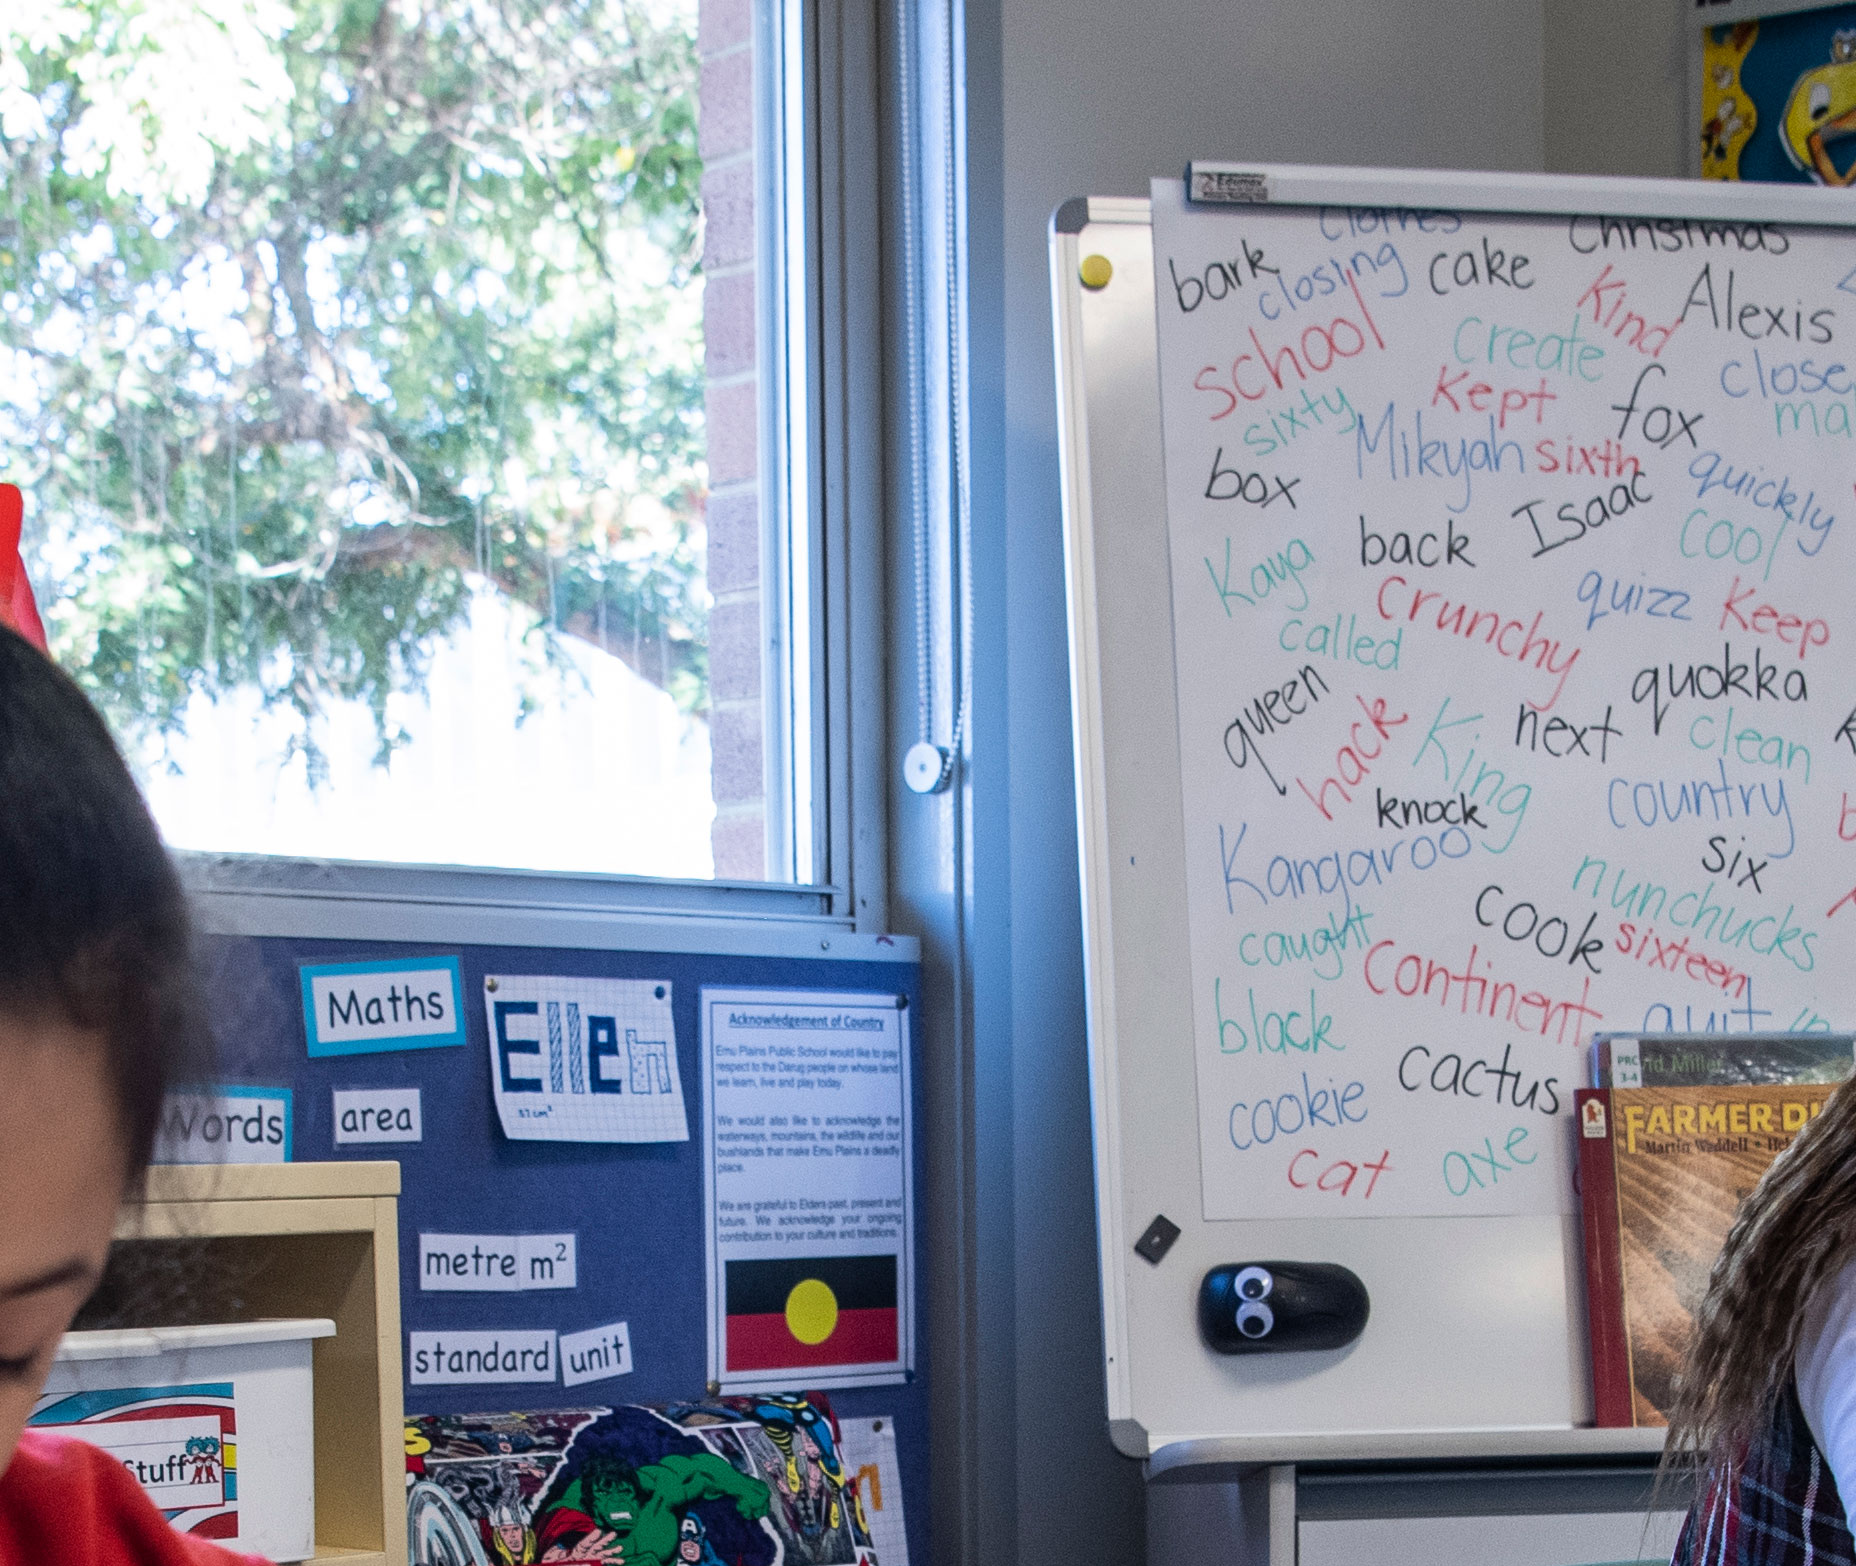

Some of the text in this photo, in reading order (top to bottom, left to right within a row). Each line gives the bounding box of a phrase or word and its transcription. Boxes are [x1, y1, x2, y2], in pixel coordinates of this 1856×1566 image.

[1169, 238, 1279, 313] bark
[1259, 242, 1409, 320] closing
[1428, 238, 1535, 295] cake
[1680, 262, 1837, 344] Alexis
[1611, 363, 1704, 450] fox
[1720, 348, 1856, 399] close
[1244, 382, 1358, 457] sixty
[1204, 447, 1301, 509] box
[1356, 402, 1524, 513] Mikyah
[1536, 437, 1640, 478] sixth
[1512, 471, 1653, 558] Isaac
[1688, 450, 1836, 556] quickly
[1204, 537, 1316, 618] Kaya
[1359, 515, 1476, 568] back
[1680, 508, 1792, 582] cool
[1279, 613, 1404, 671] called
[1632, 642, 1807, 736] quokka
[1223, 665, 1330, 796] queen
[1296, 695, 1409, 822] hack
[1515, 703, 1623, 764] next
[1689, 707, 1812, 785] clean
[1377, 787, 1489, 831] knock
[1413, 697, 1534, 855] King
[1608, 758, 1795, 859] country
[1219, 823, 1472, 935] Kangaroo
[1701, 836, 1769, 895] six
[1238, 905, 1376, 981] caught
[1476, 885, 1604, 974] cook
[1572, 855, 1818, 972] nunchucks
[1614, 922, 1748, 1001] sixteen
[326, 983, 446, 1030] Maths
[729, 1013, 884, 1031] Acknowledgement of Country
[1215, 976, 1347, 1055] black
[1229, 1071, 1369, 1151] cookie
[1398, 1044, 1560, 1115] cactus
[165, 1104, 283, 1145] Words
[341, 1104, 414, 1134] area
[1623, 1102, 1775, 1155] FARMER
[1287, 1149, 1396, 1199] cat
[1444, 1126, 1538, 1197] axe
[425, 1247, 517, 1279] metre
[414, 1337, 625, 1376] standard unit
